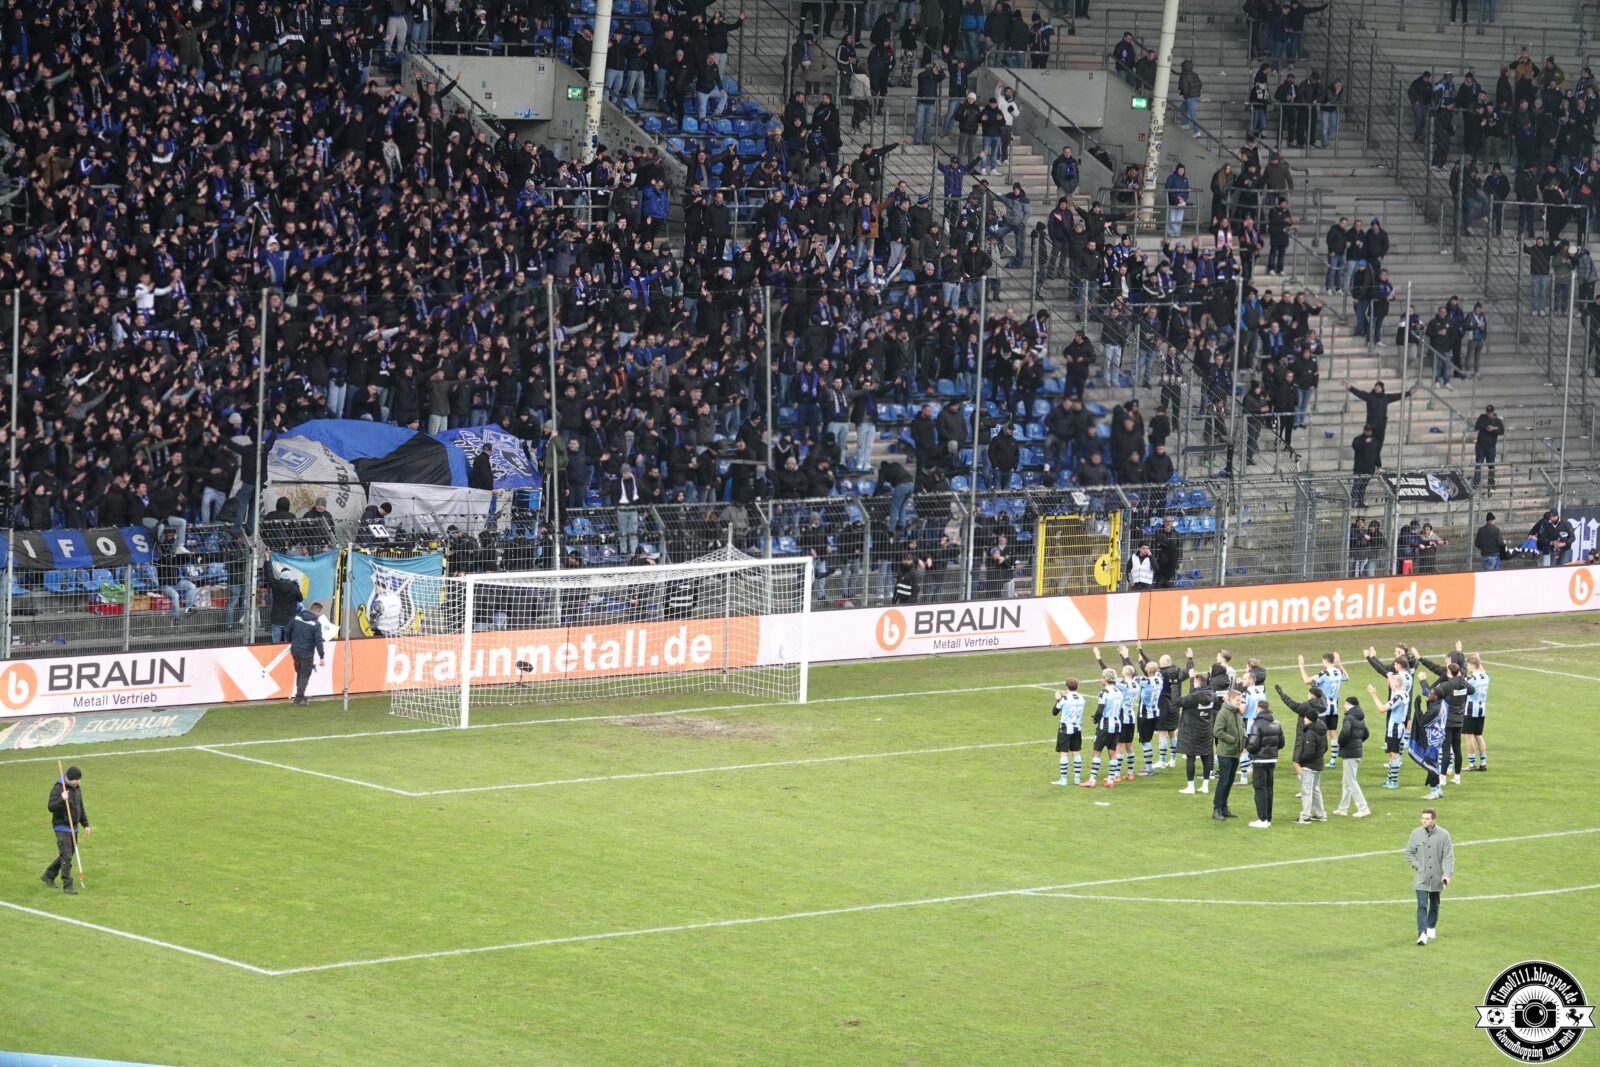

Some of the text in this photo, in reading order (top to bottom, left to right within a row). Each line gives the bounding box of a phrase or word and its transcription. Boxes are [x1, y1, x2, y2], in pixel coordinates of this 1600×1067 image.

[914, 605, 1021, 635] BRAUN
[1180, 581, 1438, 631] braunmetall.de
[386, 626, 712, 684] braunmetall.de
[933, 636, 999, 650] Metall Vertrieb
[48, 657, 186, 692] BRAUN
[73, 691, 158, 708] Metall Vertrieb
[81, 715, 178, 733] EICHBAUM
